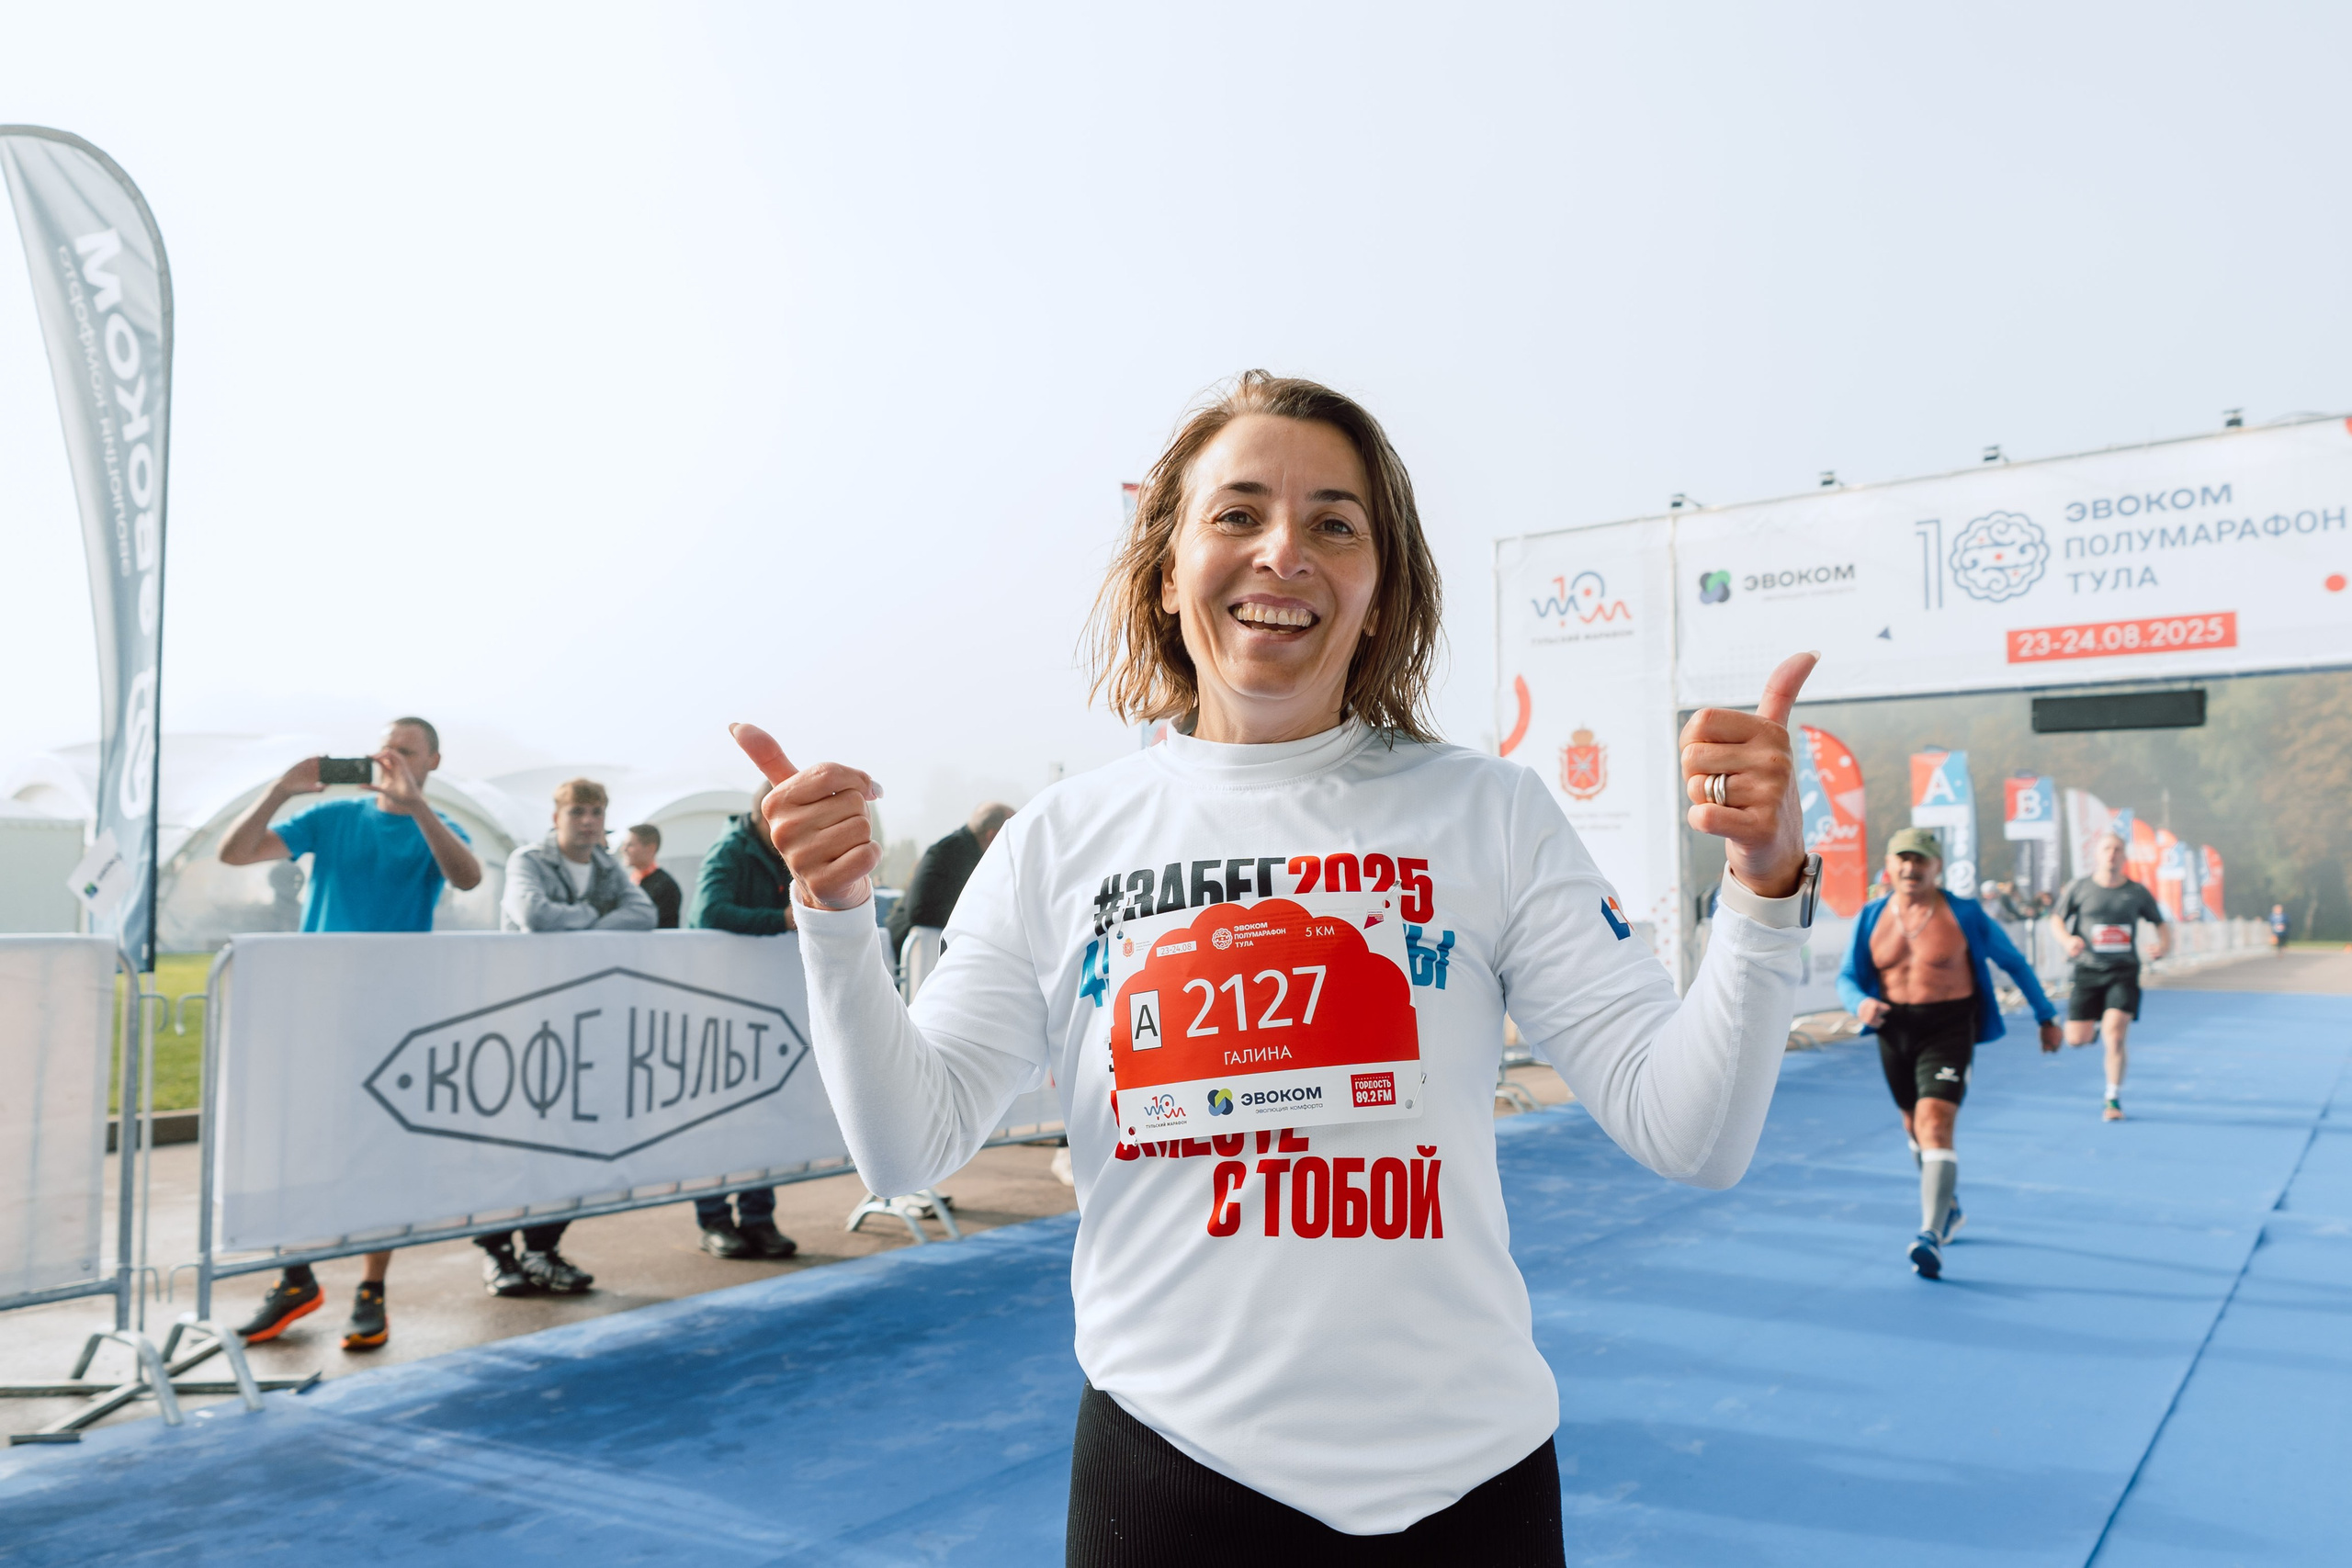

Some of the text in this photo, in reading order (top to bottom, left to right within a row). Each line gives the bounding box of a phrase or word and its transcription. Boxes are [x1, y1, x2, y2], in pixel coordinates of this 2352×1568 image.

[2064, 483, 2233, 523] ЭВОКОМ
[2064, 507, 2347, 559] ПОЛУМАРАФОН
[1744, 564, 1856, 591] ЭВОКОМ
[2066, 565, 2159, 595] ТУЛА
[2016, 615, 2225, 659] 23-24.08.2025
[1233, 921, 1269, 932] ЭВОКОМ
[1233, 927, 1286, 941] ПОЛУМАРАФОН
[1305, 926, 1313, 938] 5
[1160, 942, 1193, 955] 23-24.08
[1235, 941, 1255, 949] ТУЛА
[1182, 965, 1327, 1038] 2127
[426, 1007, 770, 1122] КОФЕ КУЛЬТ
[1224, 1044, 1293, 1066] ГАЛИНА
[1355, 1079, 1392, 1090] ГОРДОСТЬ
[1240, 1086, 1323, 1107] ЭВОКОМ
[1356, 1089, 1393, 1103] 89.2 FM
[1256, 1102, 1323, 1114] эволюция комфорта
[1206, 1145, 1444, 1241] С ТОБОЙ
